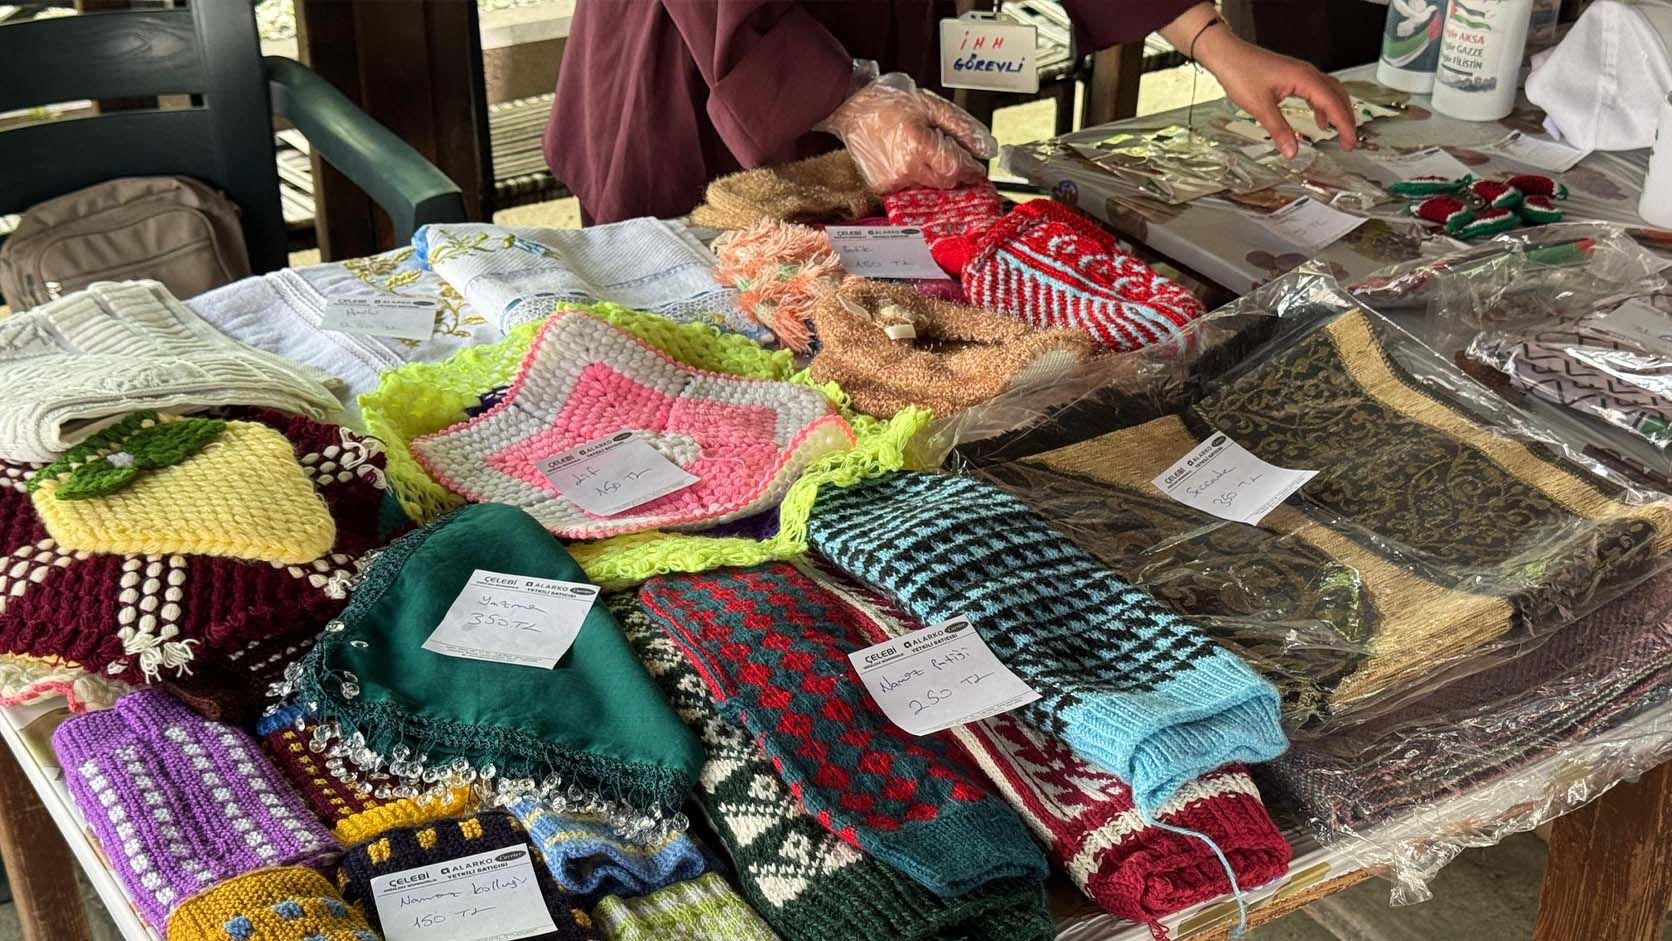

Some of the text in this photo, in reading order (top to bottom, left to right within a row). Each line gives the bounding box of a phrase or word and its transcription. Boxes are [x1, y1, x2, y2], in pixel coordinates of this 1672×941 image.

[1459, 32, 1484, 44] AKSA
[1457, 45, 1484, 57] GAZZE
[484, 576, 518, 586] ÇELEBİ
[534, 583, 569, 592] ALARKO
[913, 630, 944, 646] ALARKO
[864, 646, 897, 664] ÇELEBİ
[960, 672, 995, 685] TL
[452, 858, 493, 872] ALARKO
[389, 871, 430, 888] ÇELEBİ
[414, 914, 446, 929] 150
